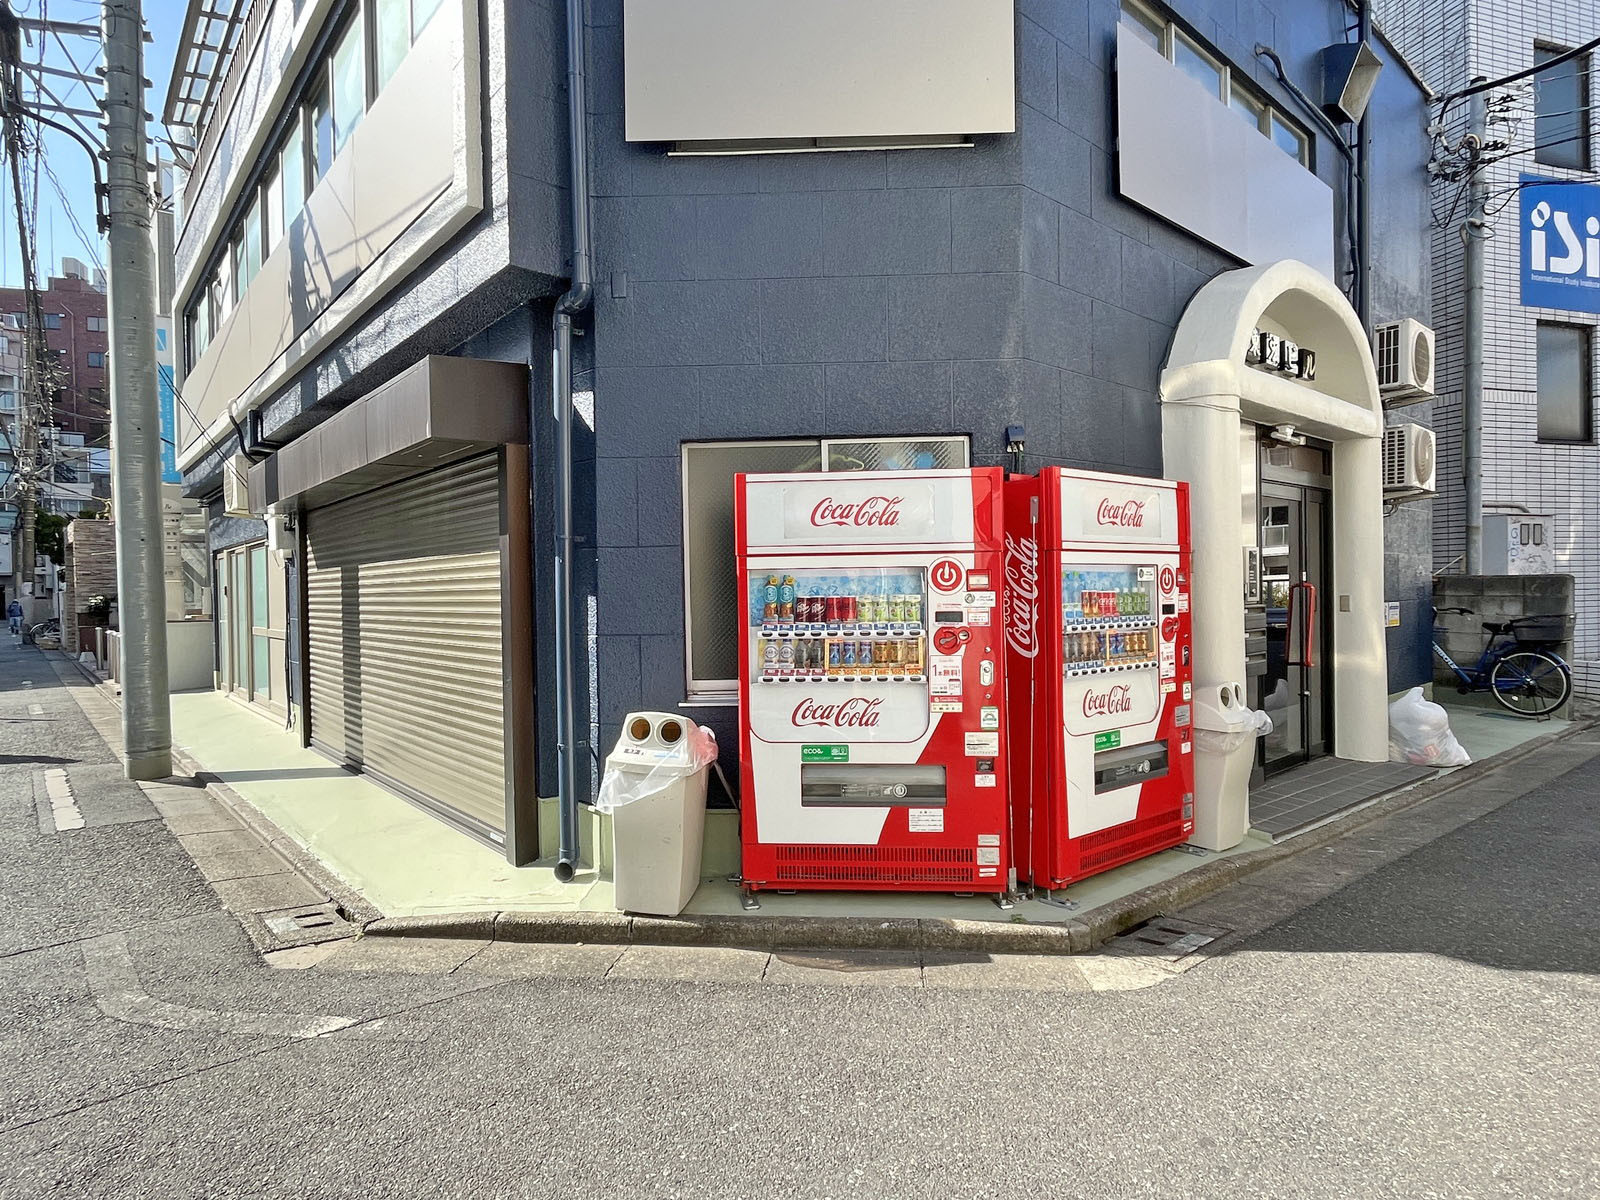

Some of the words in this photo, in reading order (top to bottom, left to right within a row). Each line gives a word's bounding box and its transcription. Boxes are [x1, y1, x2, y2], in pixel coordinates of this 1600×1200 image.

[810, 496, 905, 528] Coca-Cola
[1097, 497, 1146, 528] Coca-Cola
[1005, 531, 1039, 659] Coca-Cola
[791, 697, 886, 728] Coca-Cola
[1082, 684, 1133, 718] Coca-Cola
